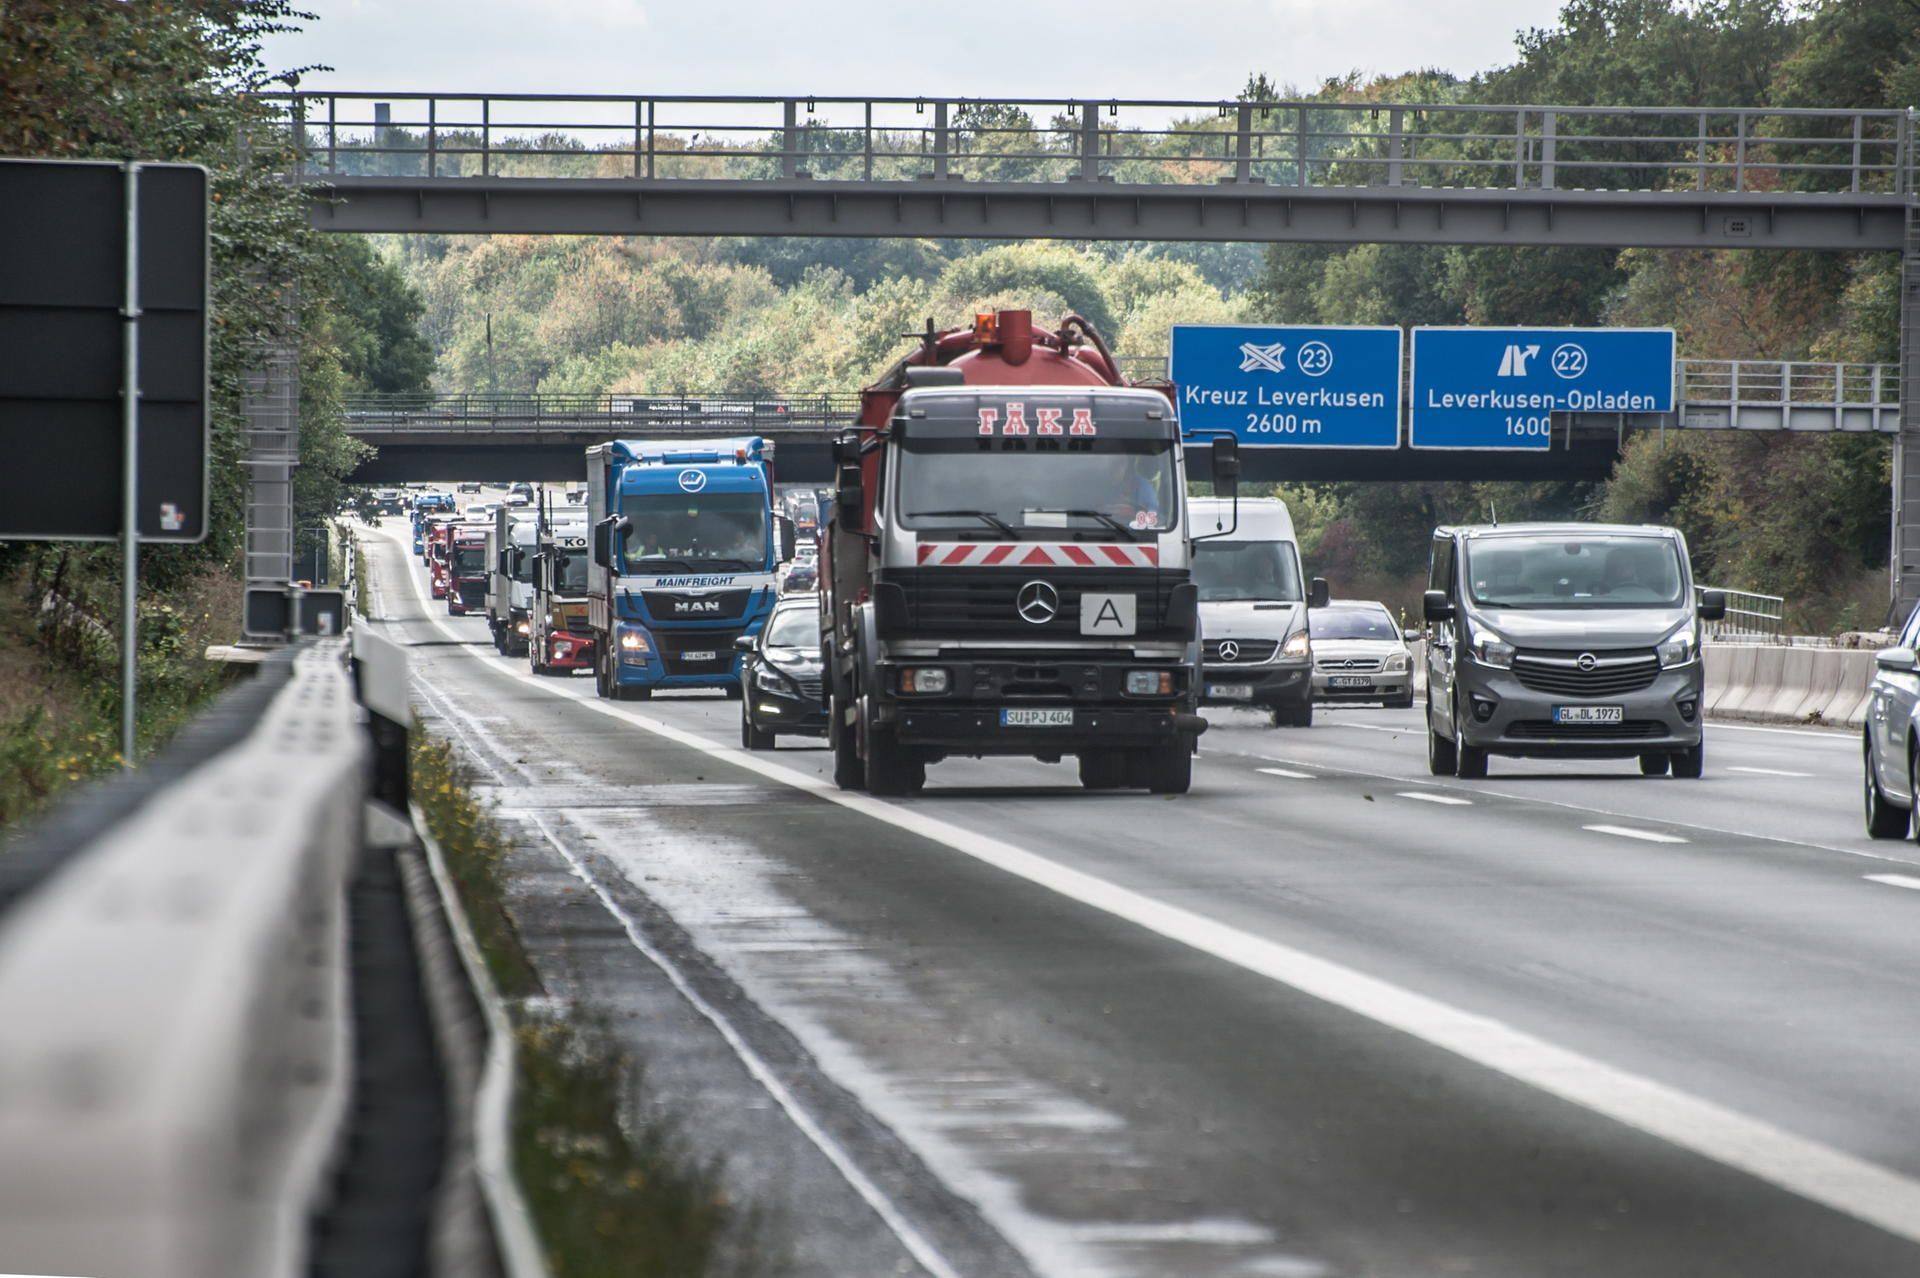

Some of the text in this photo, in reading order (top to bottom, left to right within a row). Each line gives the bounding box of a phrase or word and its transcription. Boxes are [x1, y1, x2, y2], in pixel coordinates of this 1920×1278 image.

[1303, 348, 1327, 368] 23
[1557, 351, 1582, 371] 22
[1185, 385, 1385, 407] Kreuz Leverkusen
[1428, 389, 1656, 411] Leverkusen-Opladen
[978, 402, 1096, 435] FÄKA
[1246, 413, 1322, 433] 2600 m
[656, 576, 735, 587] MAINFREIGHT
[674, 601, 720, 612] MAN
[1093, 598, 1123, 628] A
